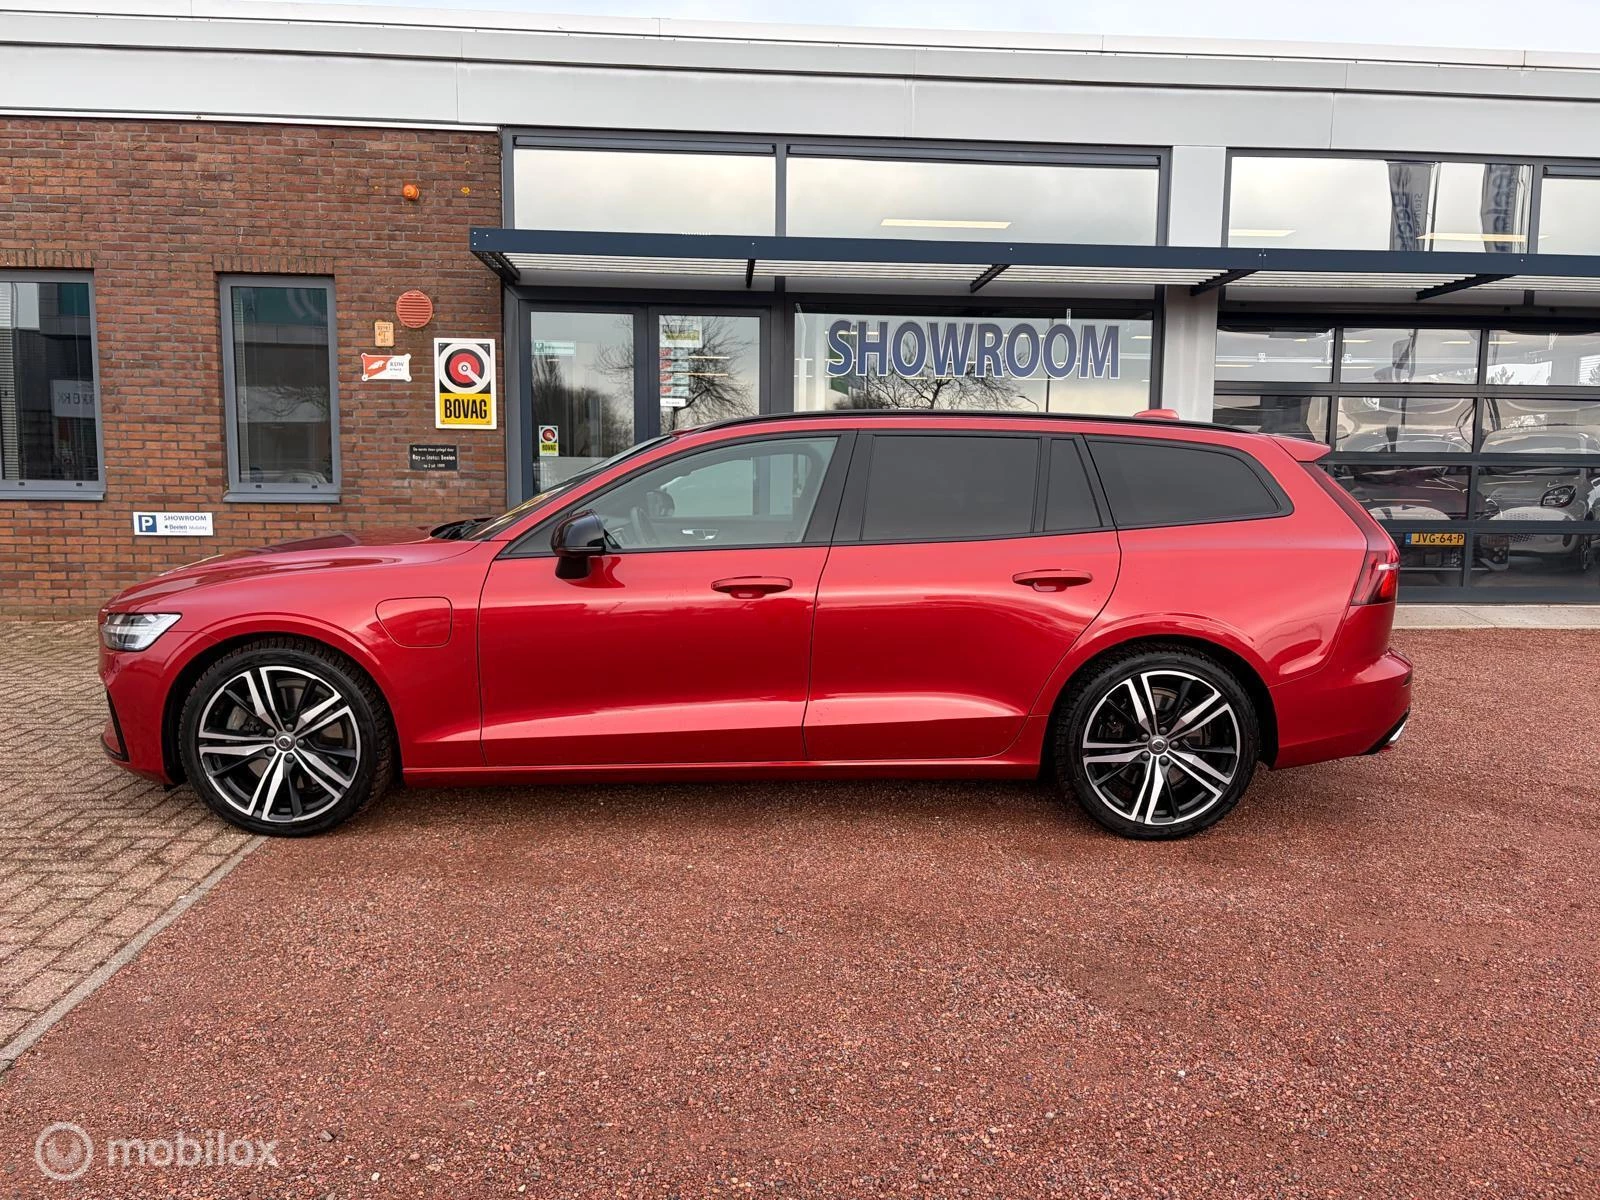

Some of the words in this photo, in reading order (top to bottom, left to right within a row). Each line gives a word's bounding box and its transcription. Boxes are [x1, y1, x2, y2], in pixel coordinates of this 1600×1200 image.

[826, 319, 1121, 380] SHOWROOM
[444, 398, 488, 420] BOVAG
[141, 516, 154, 531] P
[1415, 533, 1464, 544] JVG-64-P
